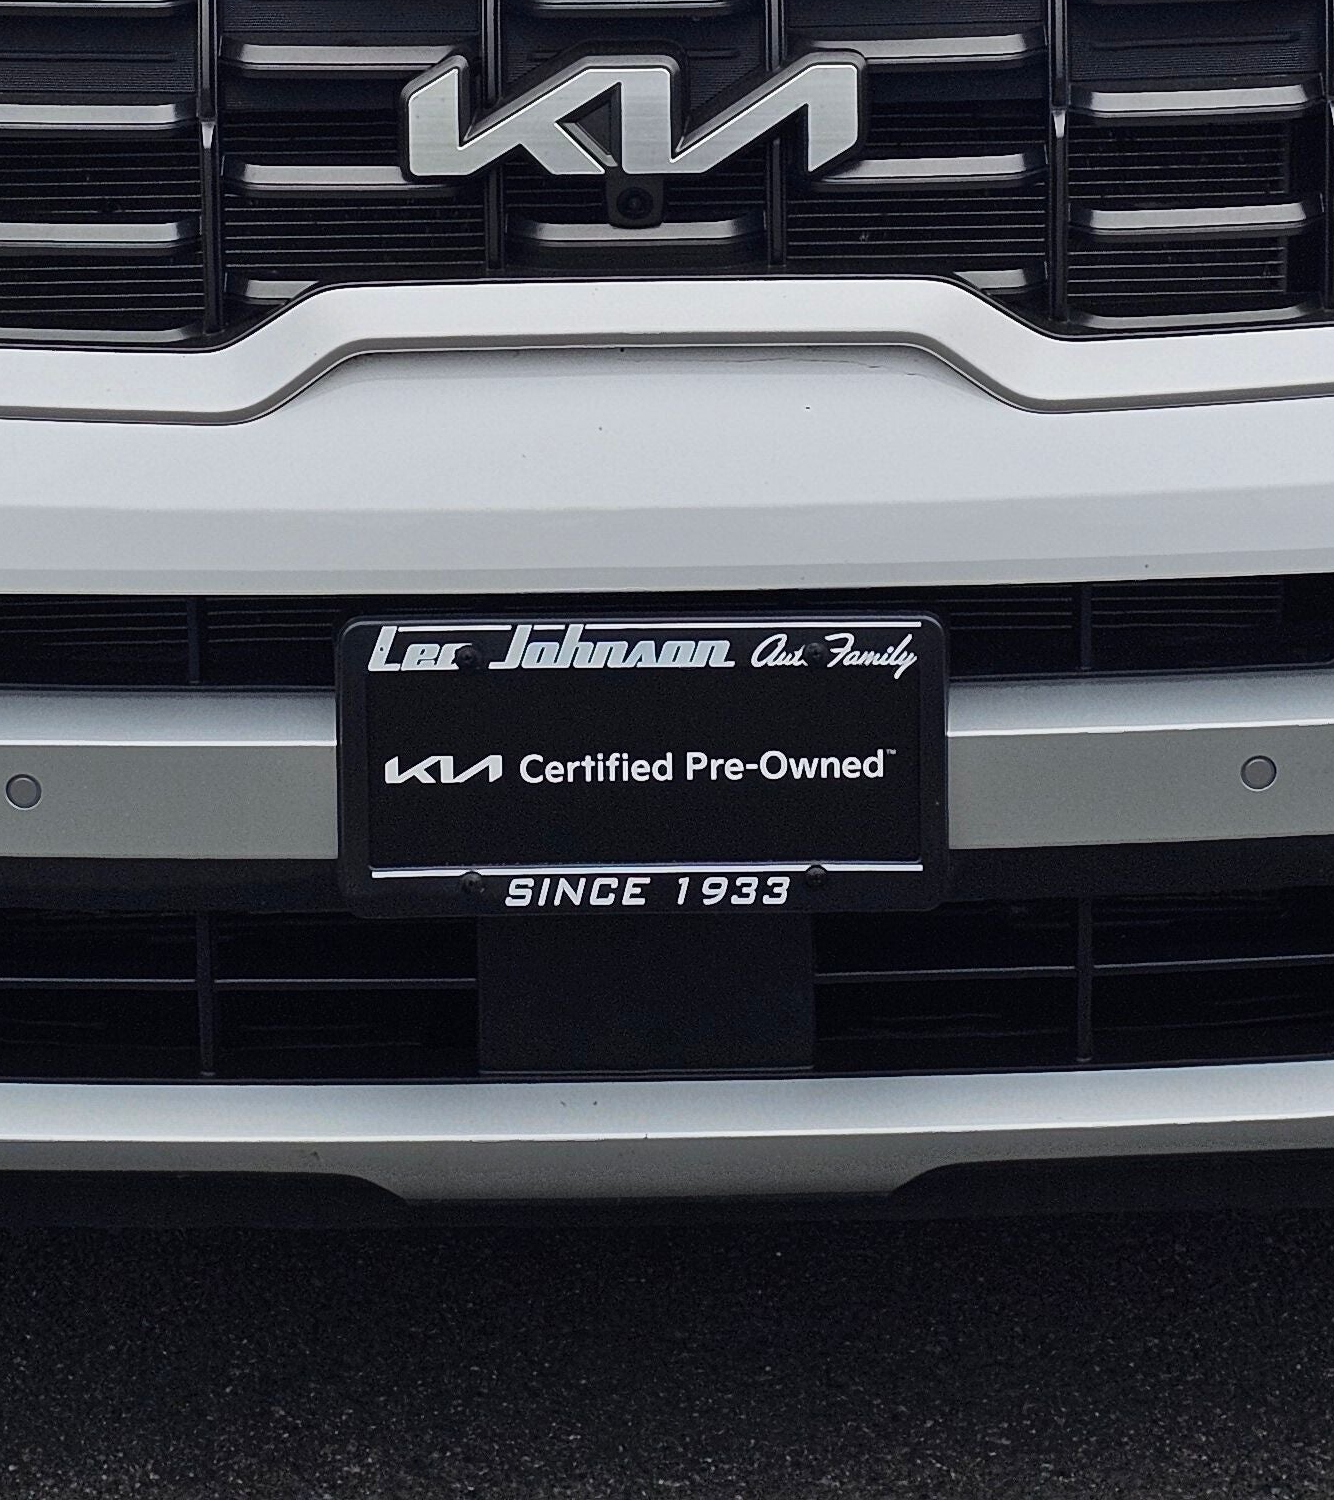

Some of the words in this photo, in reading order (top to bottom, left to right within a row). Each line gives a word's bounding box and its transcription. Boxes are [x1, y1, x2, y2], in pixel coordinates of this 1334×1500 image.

[405, 50, 863, 178] KIA
[488, 623, 736, 670] Johnson
[750, 633, 810, 669] Aut
[824, 632, 918, 680] Family
[384, 754, 503, 785] KIA
[519, 751, 673, 784] Certified
[504, 876, 651, 907] SINCE
[677, 876, 791, 905] 1933
